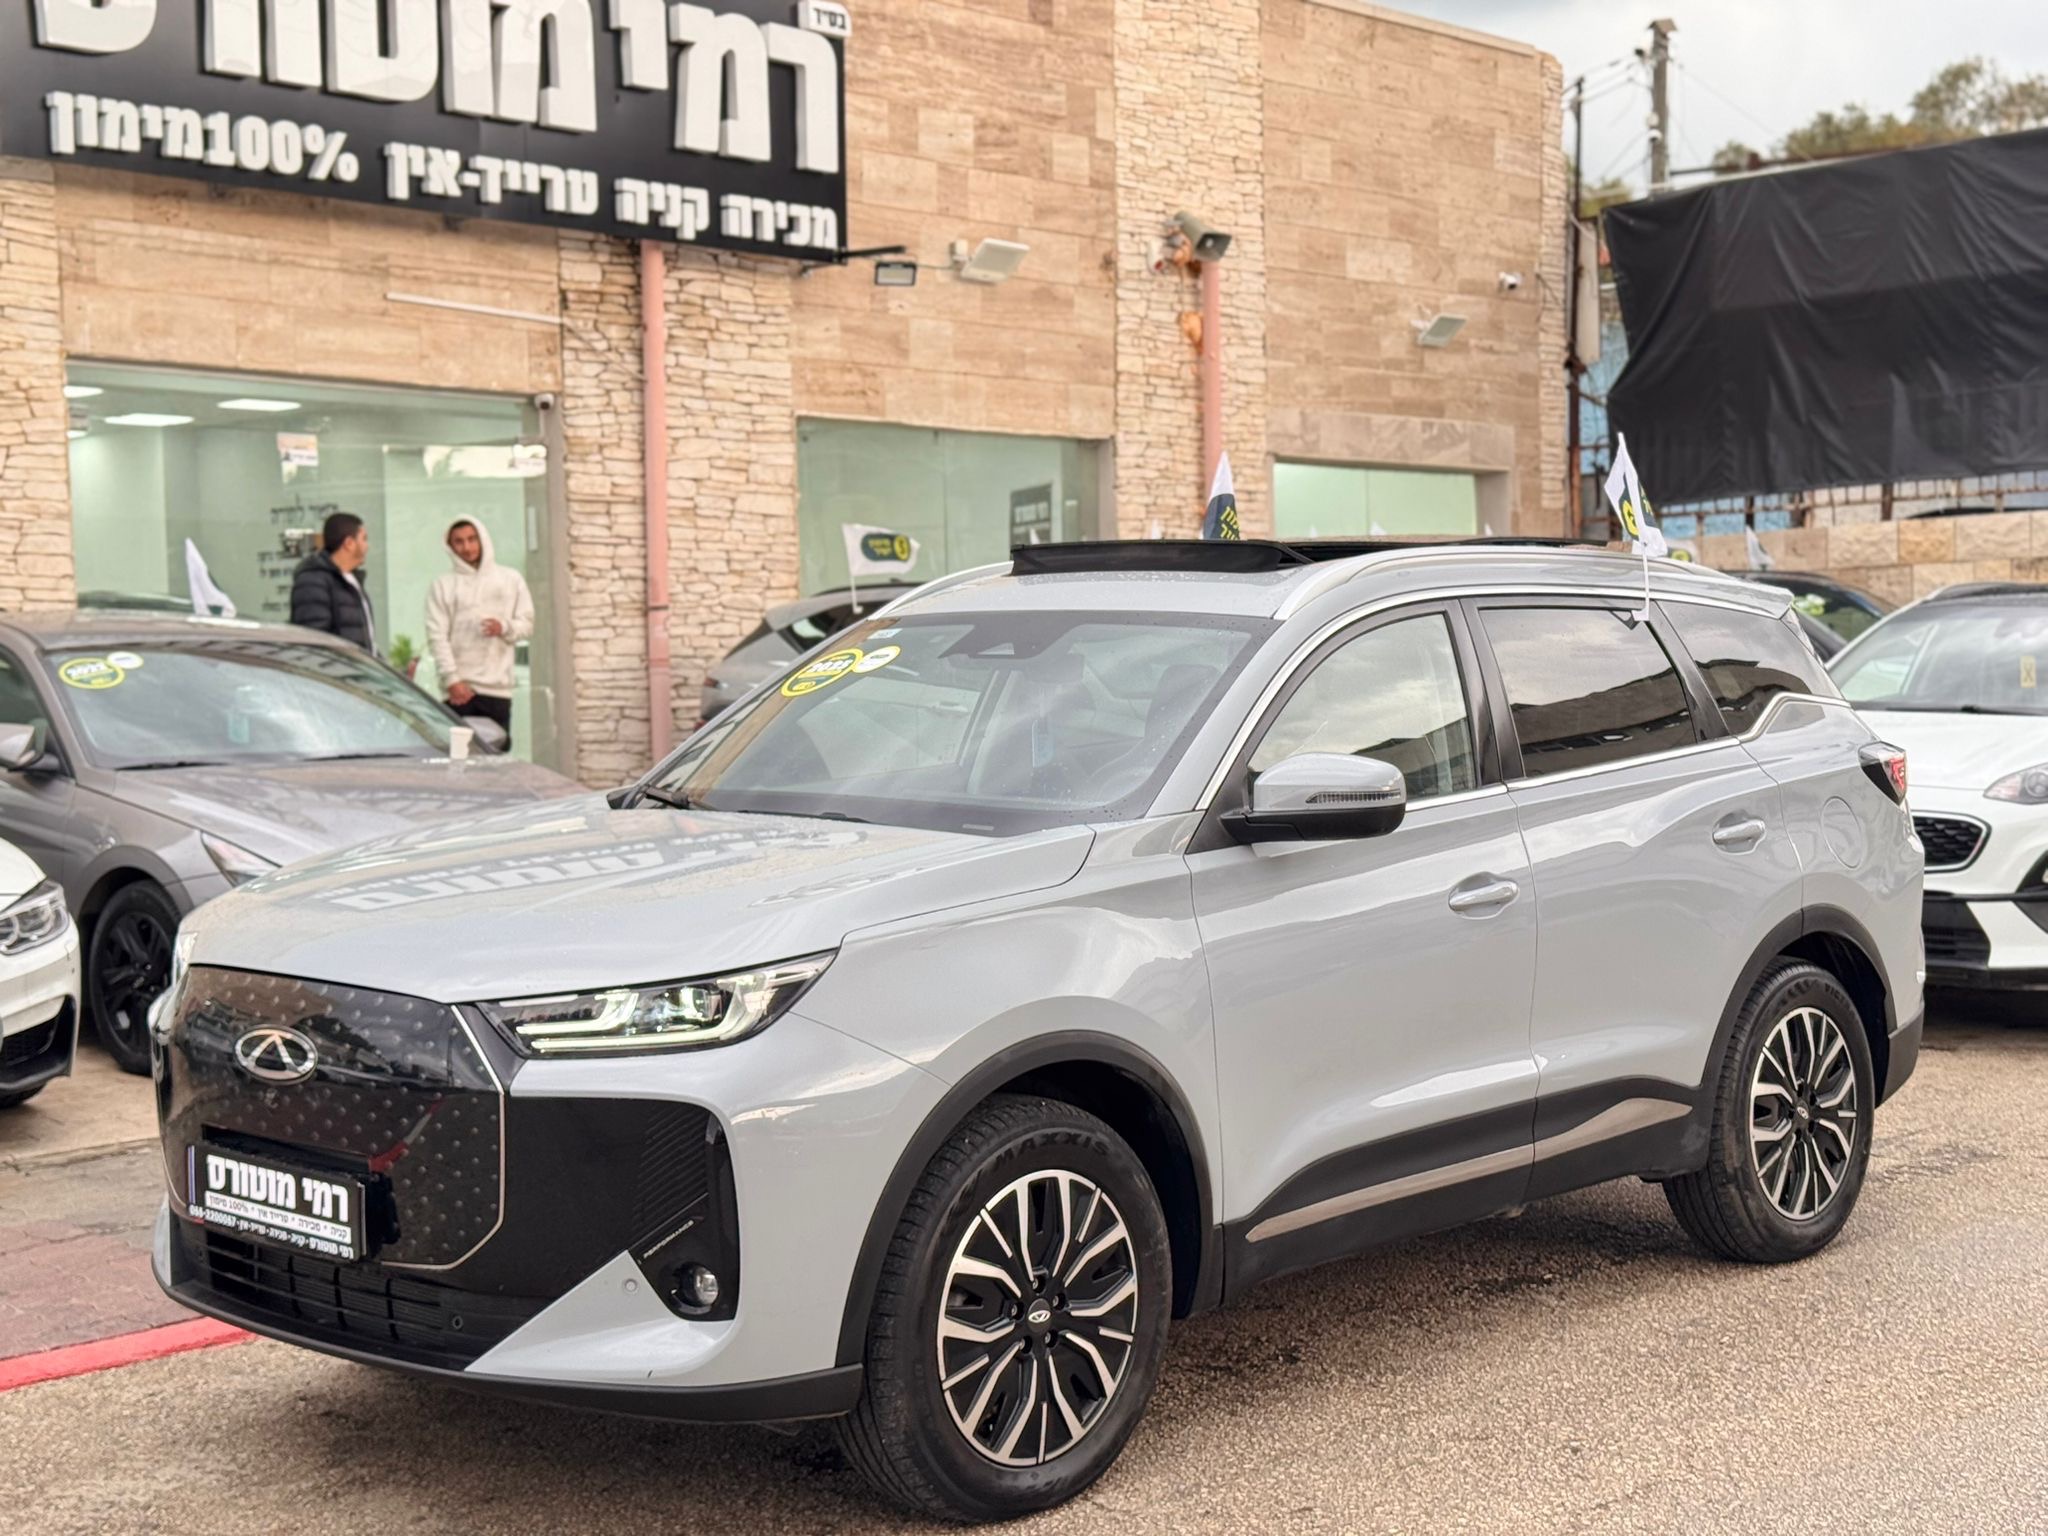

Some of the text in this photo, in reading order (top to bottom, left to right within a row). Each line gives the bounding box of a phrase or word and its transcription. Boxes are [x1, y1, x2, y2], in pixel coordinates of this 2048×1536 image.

[609, 0, 839, 174] רמי
[383, 141, 600, 215] טרייד-אין
[614, 176, 710, 240] קניה
[720, 193, 839, 249] מכירה
[994, 1131, 1111, 1171] MAXXIS
[205, 1154, 349, 1223] רמי מוטורס
[229, 1201, 249, 1213] 100%
[298, 1218, 322, 1232] מכירה
[330, 1226, 348, 1240] קניה
